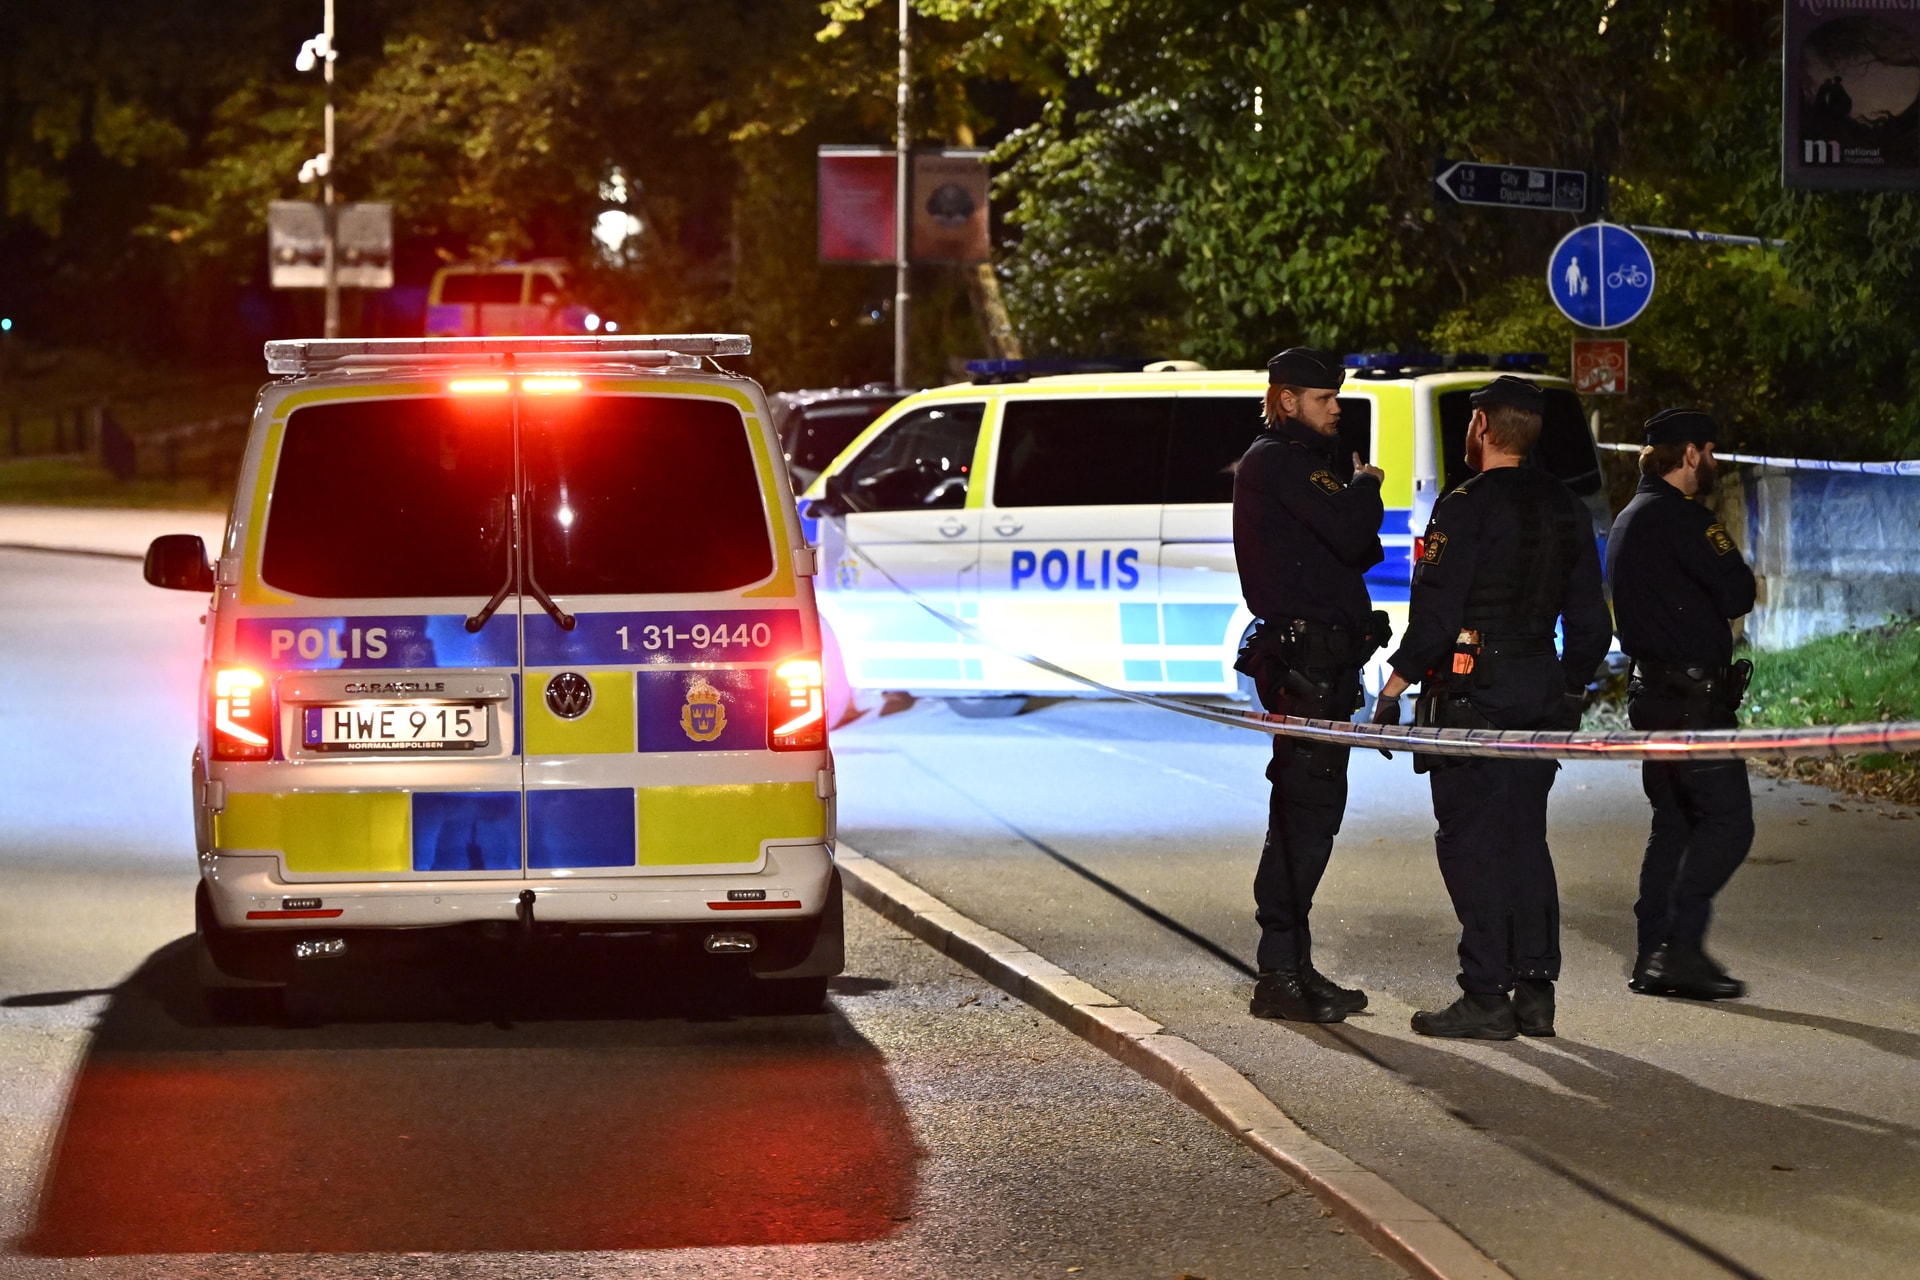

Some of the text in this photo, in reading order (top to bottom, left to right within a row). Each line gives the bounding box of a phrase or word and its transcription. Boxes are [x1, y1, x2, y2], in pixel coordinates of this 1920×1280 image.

[1500, 170, 1519, 186] City
[1011, 548, 1139, 591] POLIS
[271, 628, 388, 660] POLIS
[616, 623, 771, 650] 1 31-9440
[344, 682, 446, 694] CARAVELLE
[334, 709, 473, 740] HWE 915
[348, 741, 443, 750] NORRMALMSPOLISEN
